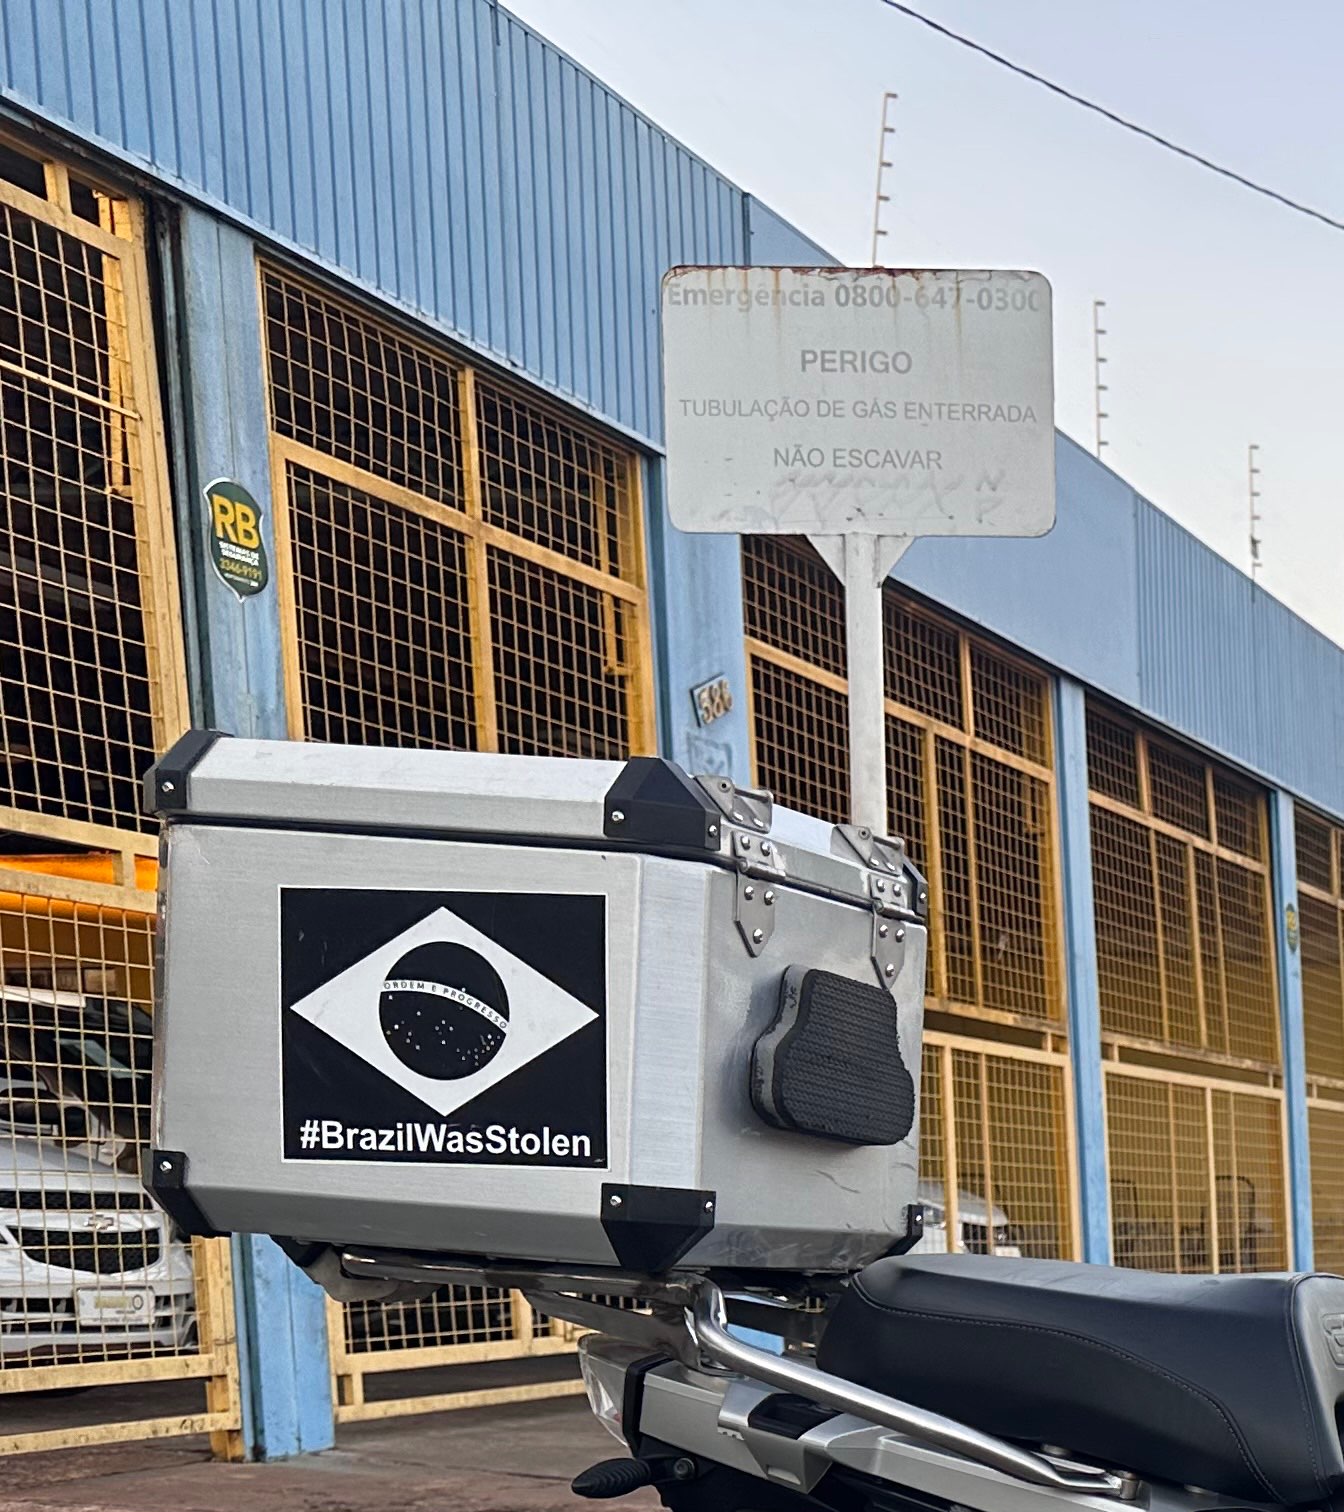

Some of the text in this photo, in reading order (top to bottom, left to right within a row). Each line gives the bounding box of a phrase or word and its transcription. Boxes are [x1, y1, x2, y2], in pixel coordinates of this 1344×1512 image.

[667, 283, 825, 313] Emergência
[800, 349, 912, 374] PERIGO
[680, 397, 1037, 423] TUBULAÇÃO DE GÁS ENTERRADA
[774, 445, 943, 471] NÃO ESCAVAR
[211, 494, 260, 549] RB
[384, 981, 425, 990] ORDEM
[443, 988, 508, 1029] PROGRESSO
[300, 1119, 591, 1157] #BrazilWasStolen
